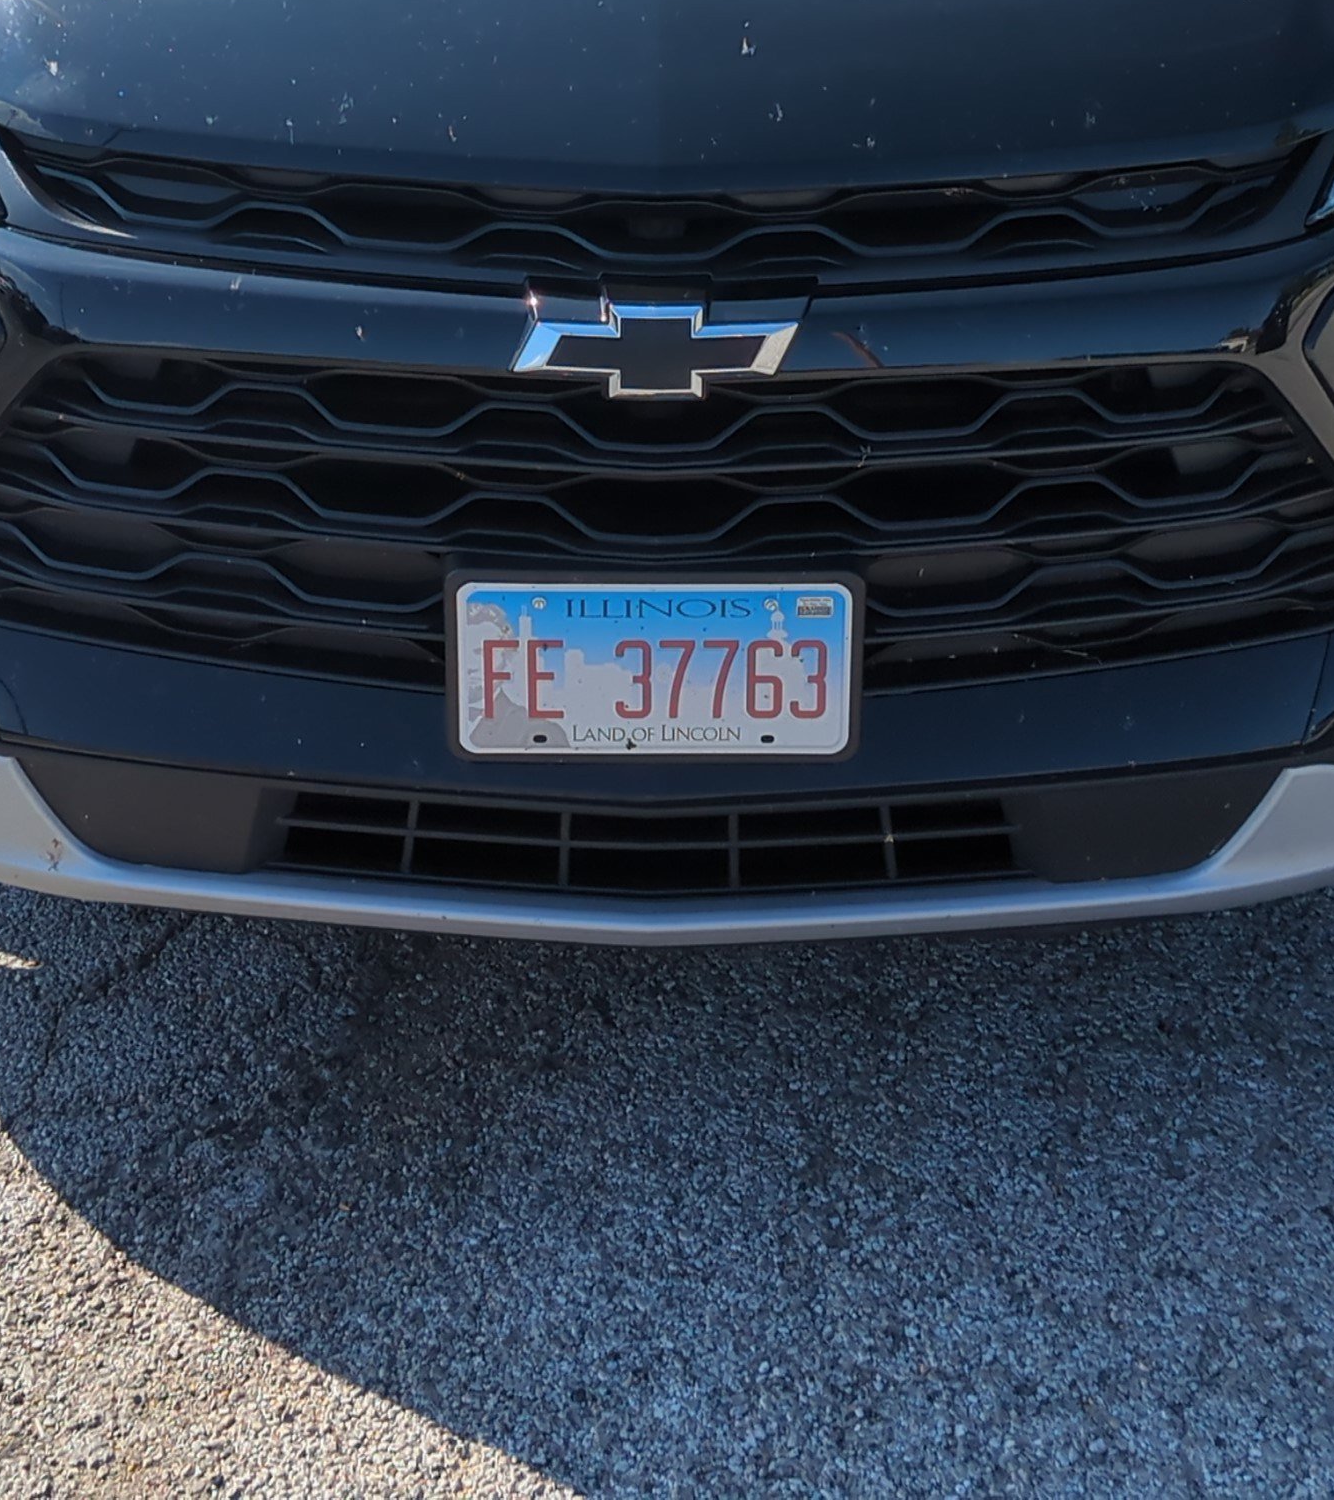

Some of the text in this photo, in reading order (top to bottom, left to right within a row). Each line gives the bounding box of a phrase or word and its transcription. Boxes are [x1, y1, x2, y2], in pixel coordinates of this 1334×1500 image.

[566, 598, 751, 619] ILLINOIS
[482, 639, 828, 719] FE 37763
